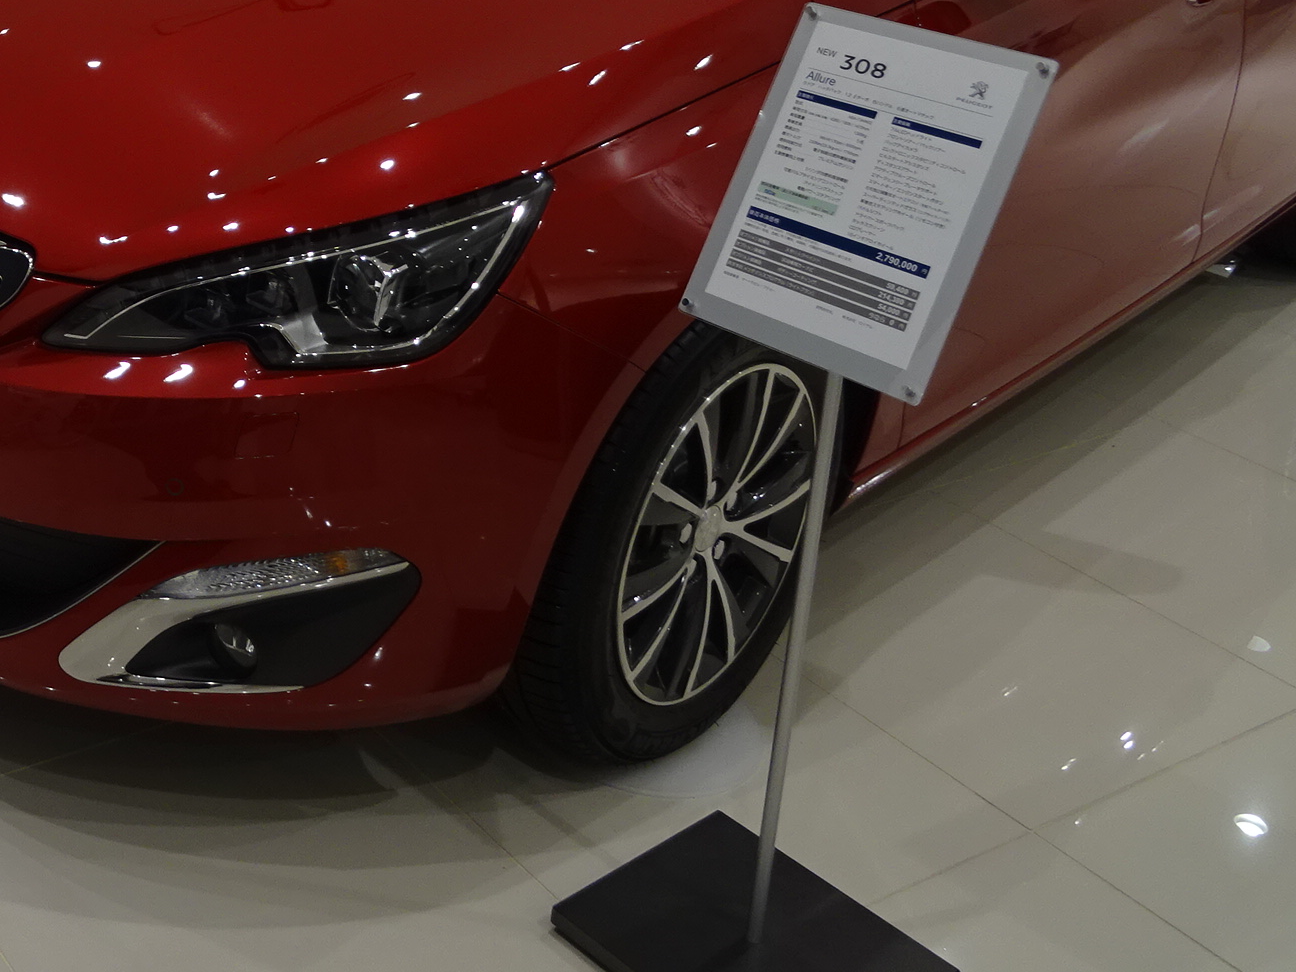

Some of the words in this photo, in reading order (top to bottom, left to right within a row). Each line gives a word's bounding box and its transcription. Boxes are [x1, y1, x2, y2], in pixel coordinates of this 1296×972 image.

[816, 47, 837, 58] NEW
[840, 54, 887, 79] 308
[806, 70, 836, 86] Allure
[956, 96, 993, 110] PEUGEOT
[875, 252, 918, 272] 2,790,000
